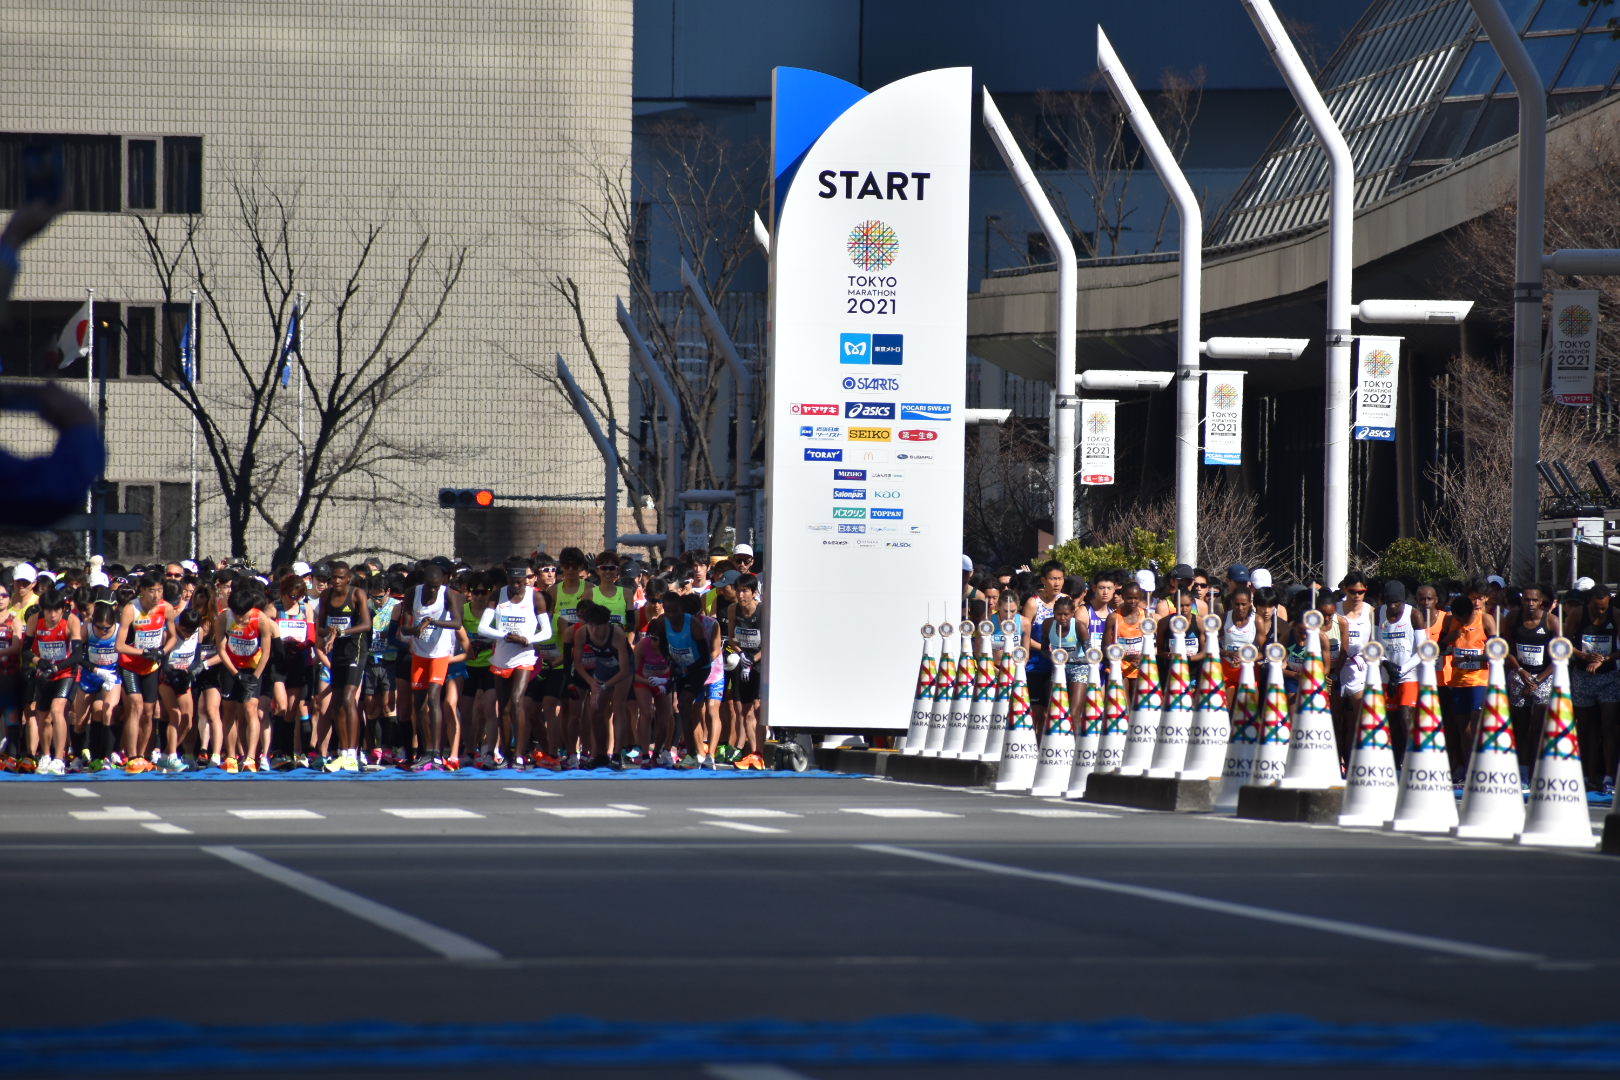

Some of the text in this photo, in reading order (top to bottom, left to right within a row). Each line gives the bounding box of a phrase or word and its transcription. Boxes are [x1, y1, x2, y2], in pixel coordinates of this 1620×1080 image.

[818, 170, 931, 200] START
[848, 276, 897, 287] TOKYO
[848, 289, 896, 297] MARATHON
[847, 298, 896, 314] 2021
[1559, 340, 1591, 349] TOKYO
[1558, 354, 1590, 366] 2021
[1362, 393, 1392, 404] 2021
[1211, 423, 1237, 432] 2021
[849, 429, 890, 439] SEIKO
[1086, 446, 1110, 455] 2021
[834, 490, 864, 499] Salonpas
[969, 714, 989, 723] TOK
[1005, 743, 1038, 752] TOKYO
[1351, 765, 1394, 778] TOKYO
[1471, 770, 1518, 785] TOKYO
